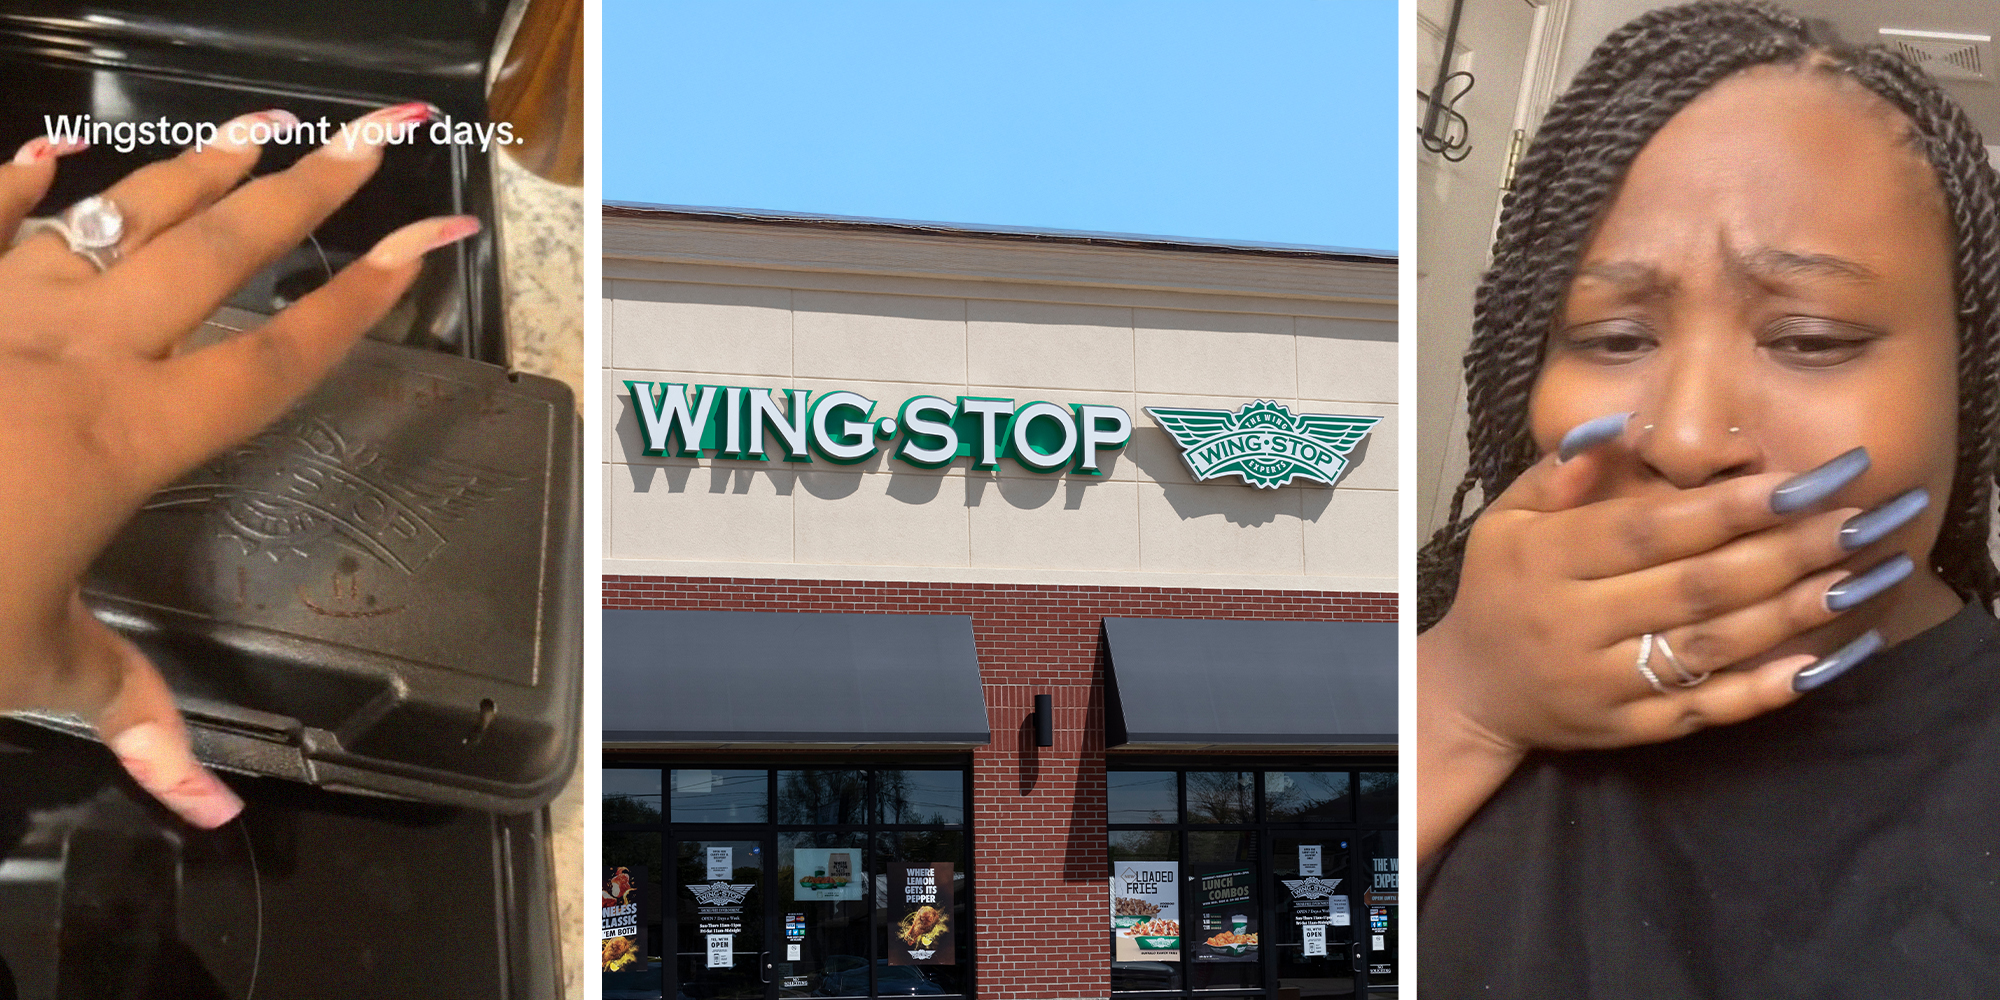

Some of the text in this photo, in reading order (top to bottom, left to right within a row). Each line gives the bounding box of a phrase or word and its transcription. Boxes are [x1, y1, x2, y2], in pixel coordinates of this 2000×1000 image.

[1245, 414, 1288, 430] THE WING
[1248, 460, 1287, 474] EXPERTS
[1373, 858, 1388, 872] THE
[906, 868, 935, 876] WHERE
[1136, 871, 1174, 883] LOADED
[906, 877, 935, 885] LEMON
[1202, 877, 1234, 891] LUNCH
[905, 886, 937, 894] GETS ITS
[1126, 883, 1158, 894] FRIES
[1208, 886, 1250, 900] COMBOS
[906, 895, 936, 903] PEPPER
[603, 927, 635, 938] 'EM BOTH
